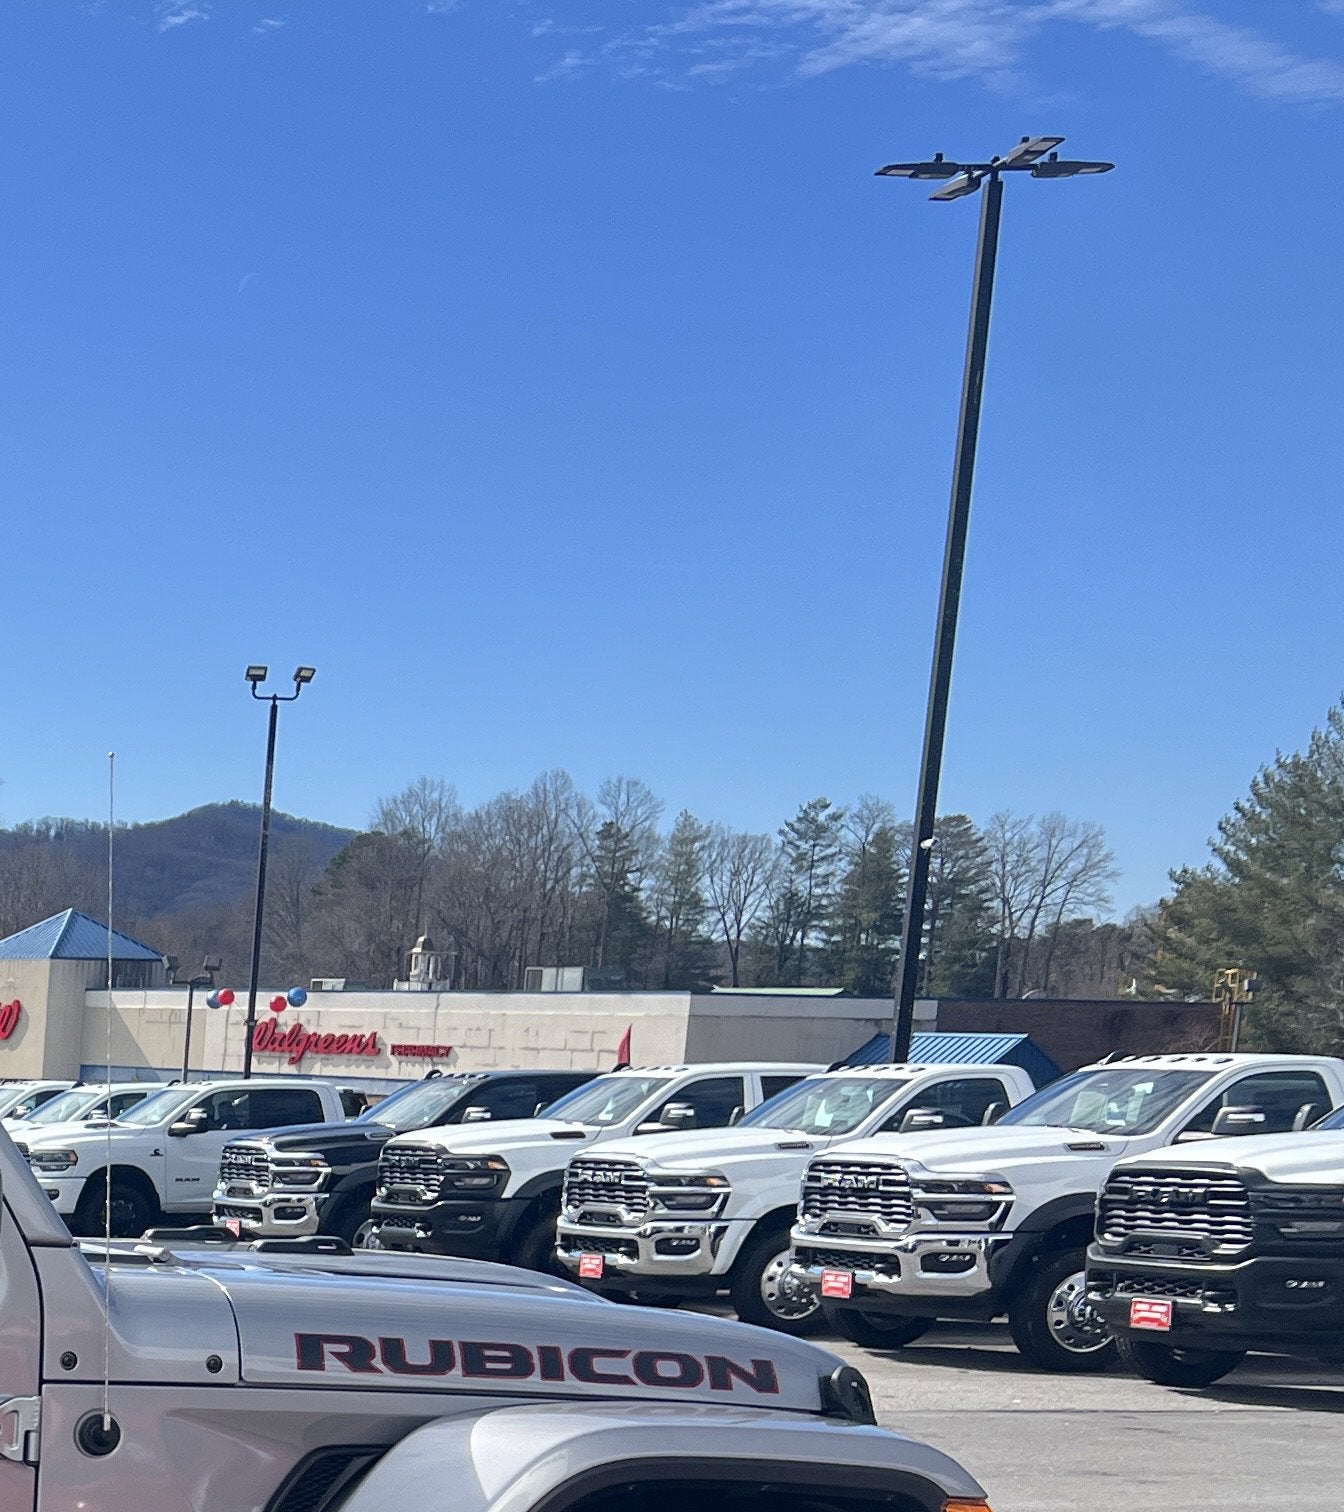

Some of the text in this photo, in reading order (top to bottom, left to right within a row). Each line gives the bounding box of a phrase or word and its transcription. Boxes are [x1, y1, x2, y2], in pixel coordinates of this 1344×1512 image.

[252, 1016, 381, 1066] Walgreens
[578, 1170, 623, 1184] RAM
[820, 1172, 880, 1190] RAM
[1130, 1186, 1208, 1204] RAM
[294, 1333, 780, 1394] RUBICON
